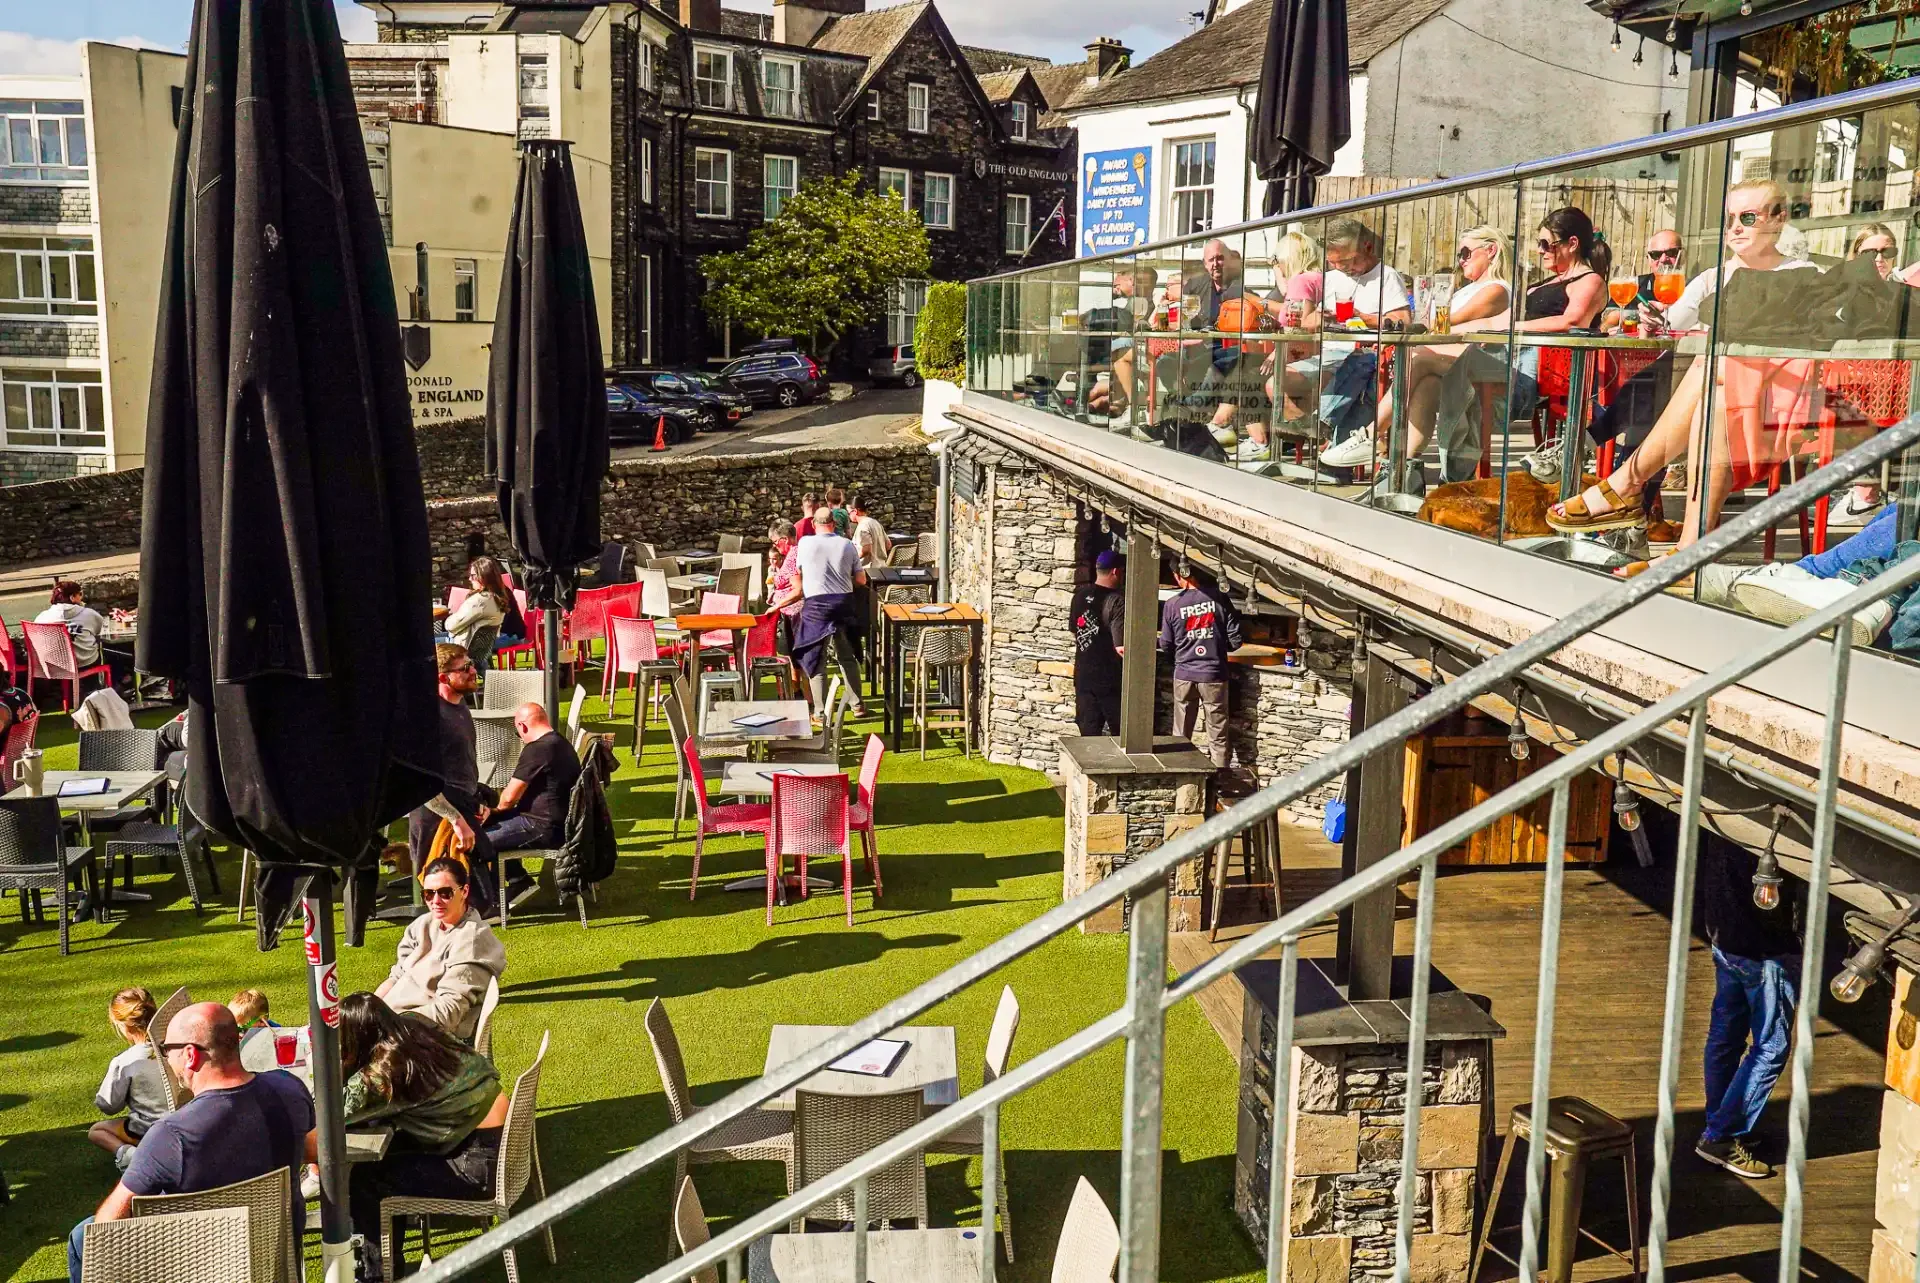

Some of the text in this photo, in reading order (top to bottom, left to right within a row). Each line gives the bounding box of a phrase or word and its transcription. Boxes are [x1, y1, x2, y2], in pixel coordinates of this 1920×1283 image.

[1102, 159, 1128, 171] AWARD
[988, 163, 1006, 174] THE
[1008, 166, 1027, 176] OLD
[1028, 169, 1068, 181] ENGLAND
[1100, 172, 1129, 184] WINNING
[1092, 183, 1137, 197] WINDERMERE
[1087, 196, 1144, 210] DAIRY ICE CREAM
[1103, 210, 1123, 221] UP TO
[1101, 222, 1135, 234] FLAVOURS
[1095, 235, 1130, 247] AVAILABLE
[406, 376, 453, 387] DONALD
[417, 389, 484, 404] ENGLAND
[421, 408, 430, 418] &
[434, 407, 453, 418] SPA
[1179, 600, 1216, 620] FRESH
